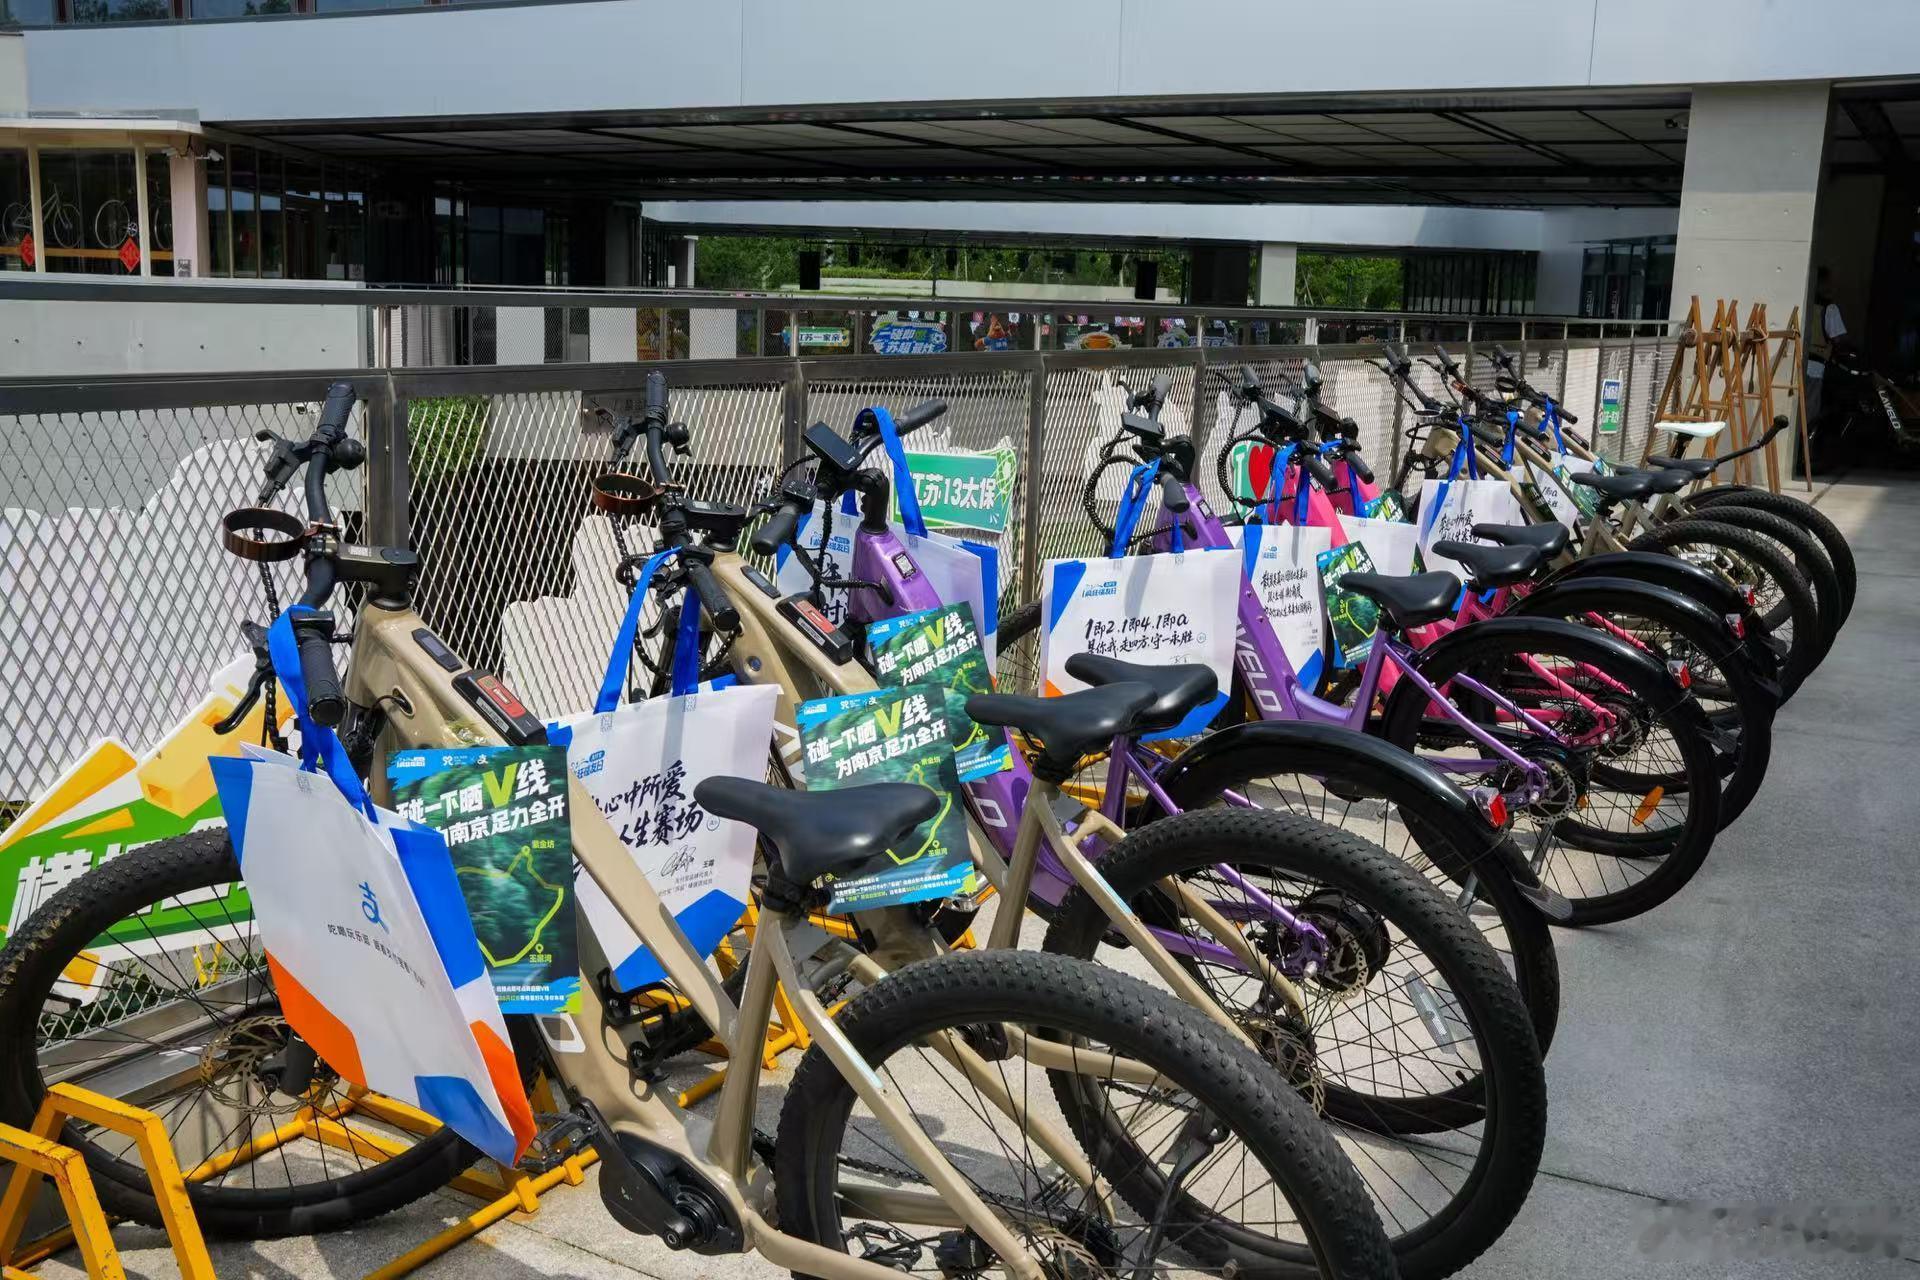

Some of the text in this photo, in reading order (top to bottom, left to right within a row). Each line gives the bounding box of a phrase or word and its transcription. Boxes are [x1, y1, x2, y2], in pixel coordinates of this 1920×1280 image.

[876, 611, 966, 676] 碰一下晒V线
[900, 630, 978, 687] 为南京足力全开
[806, 694, 932, 765] 碰一下晒V线
[835, 718, 947, 780] 为南京足力全开
[396, 758, 550, 824] 碰一下晒V线
